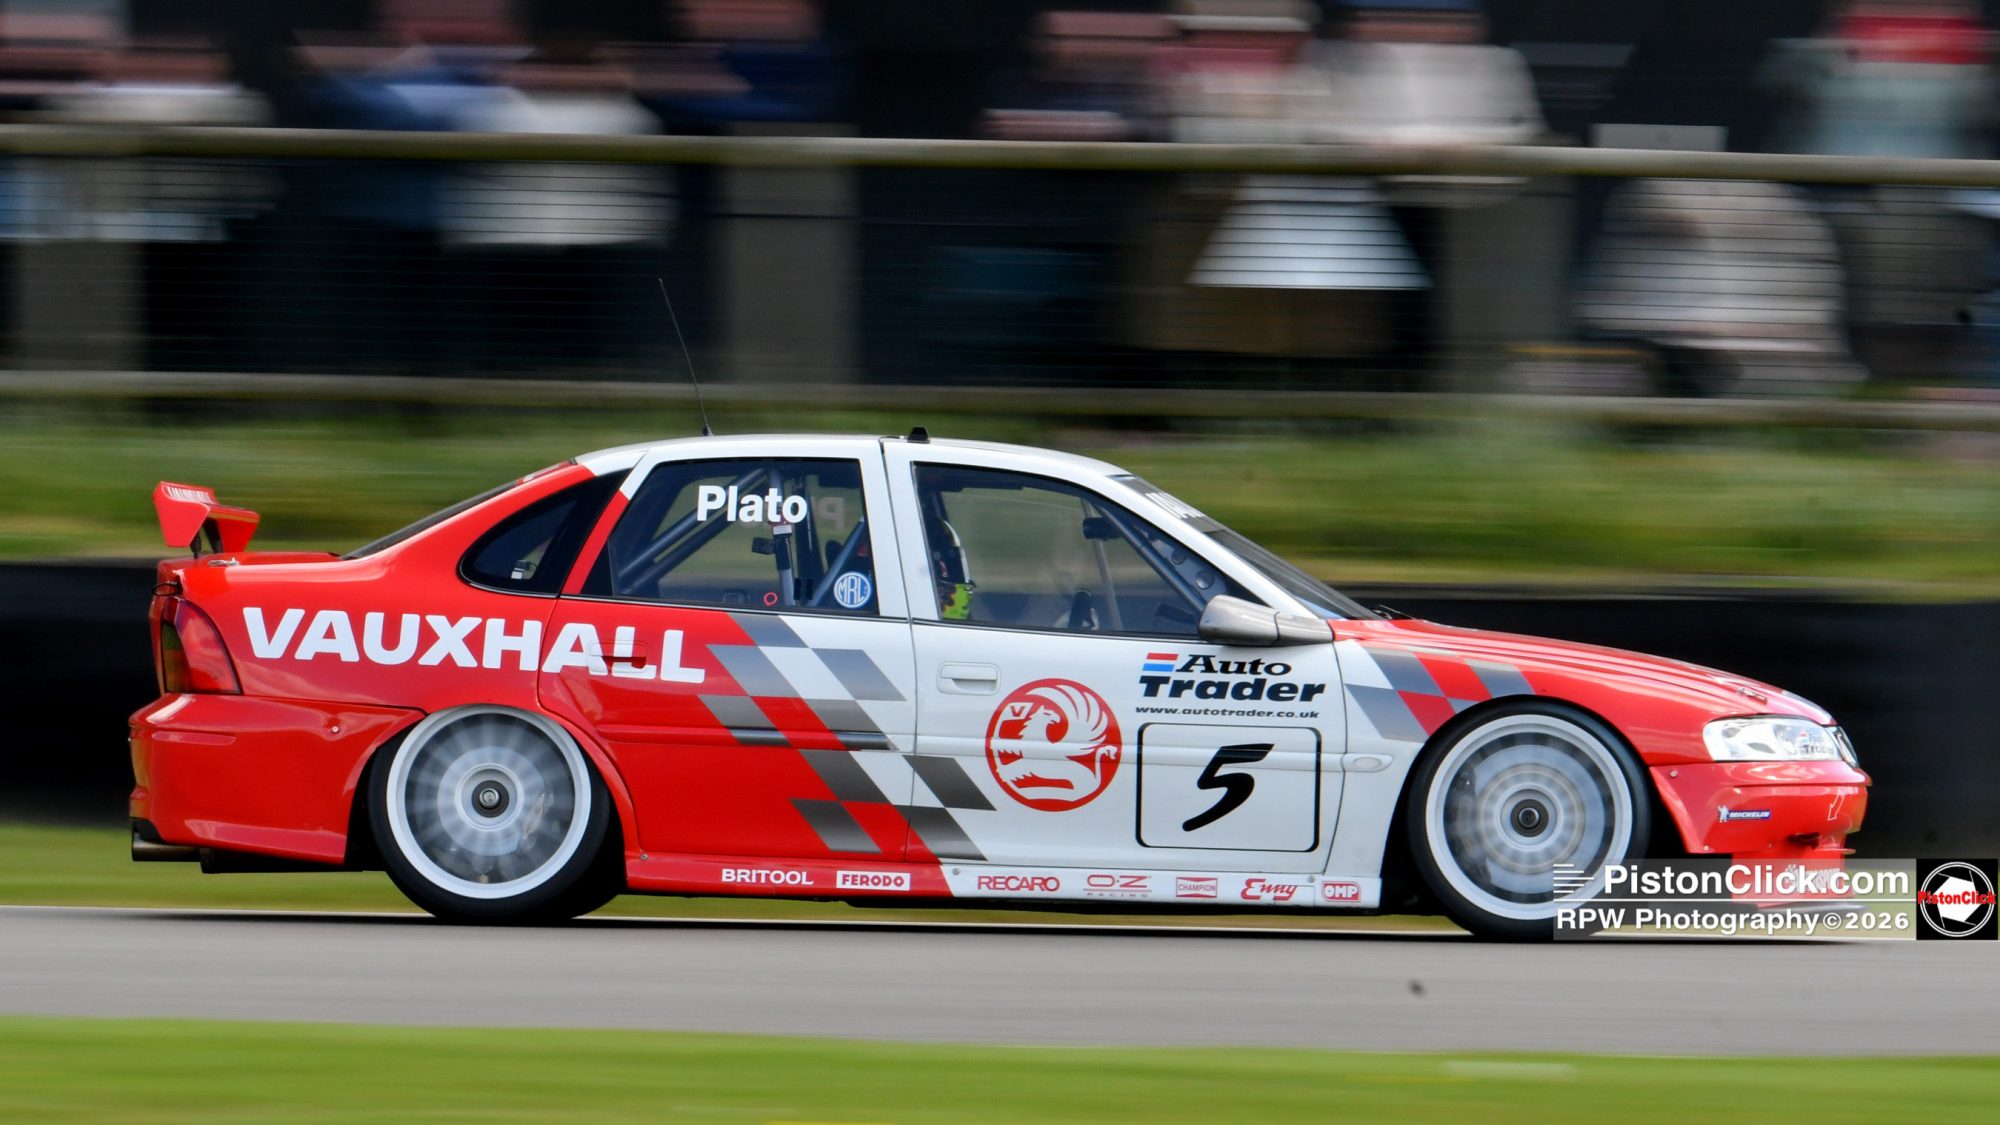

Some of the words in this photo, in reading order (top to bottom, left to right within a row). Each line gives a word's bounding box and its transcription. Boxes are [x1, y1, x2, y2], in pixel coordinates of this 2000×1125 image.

[697, 485, 808, 524] Plato
[837, 575, 866, 605] MRL
[242, 606, 705, 684] VAUXHALL
[1175, 654, 1292, 676] Auto
[1139, 675, 1326, 702] Trader
[1135, 706, 1320, 719] www.autotrader.co.uk
[1181, 743, 1275, 832] 5
[1728, 811, 1770, 819] MICHELIN
[721, 868, 814, 886] BRITOOL
[842, 873, 905, 888] FERODO
[977, 875, 1061, 892] RECARO
[1178, 883, 1217, 892] CHAMPION
[1324, 885, 1358, 898] OMP
